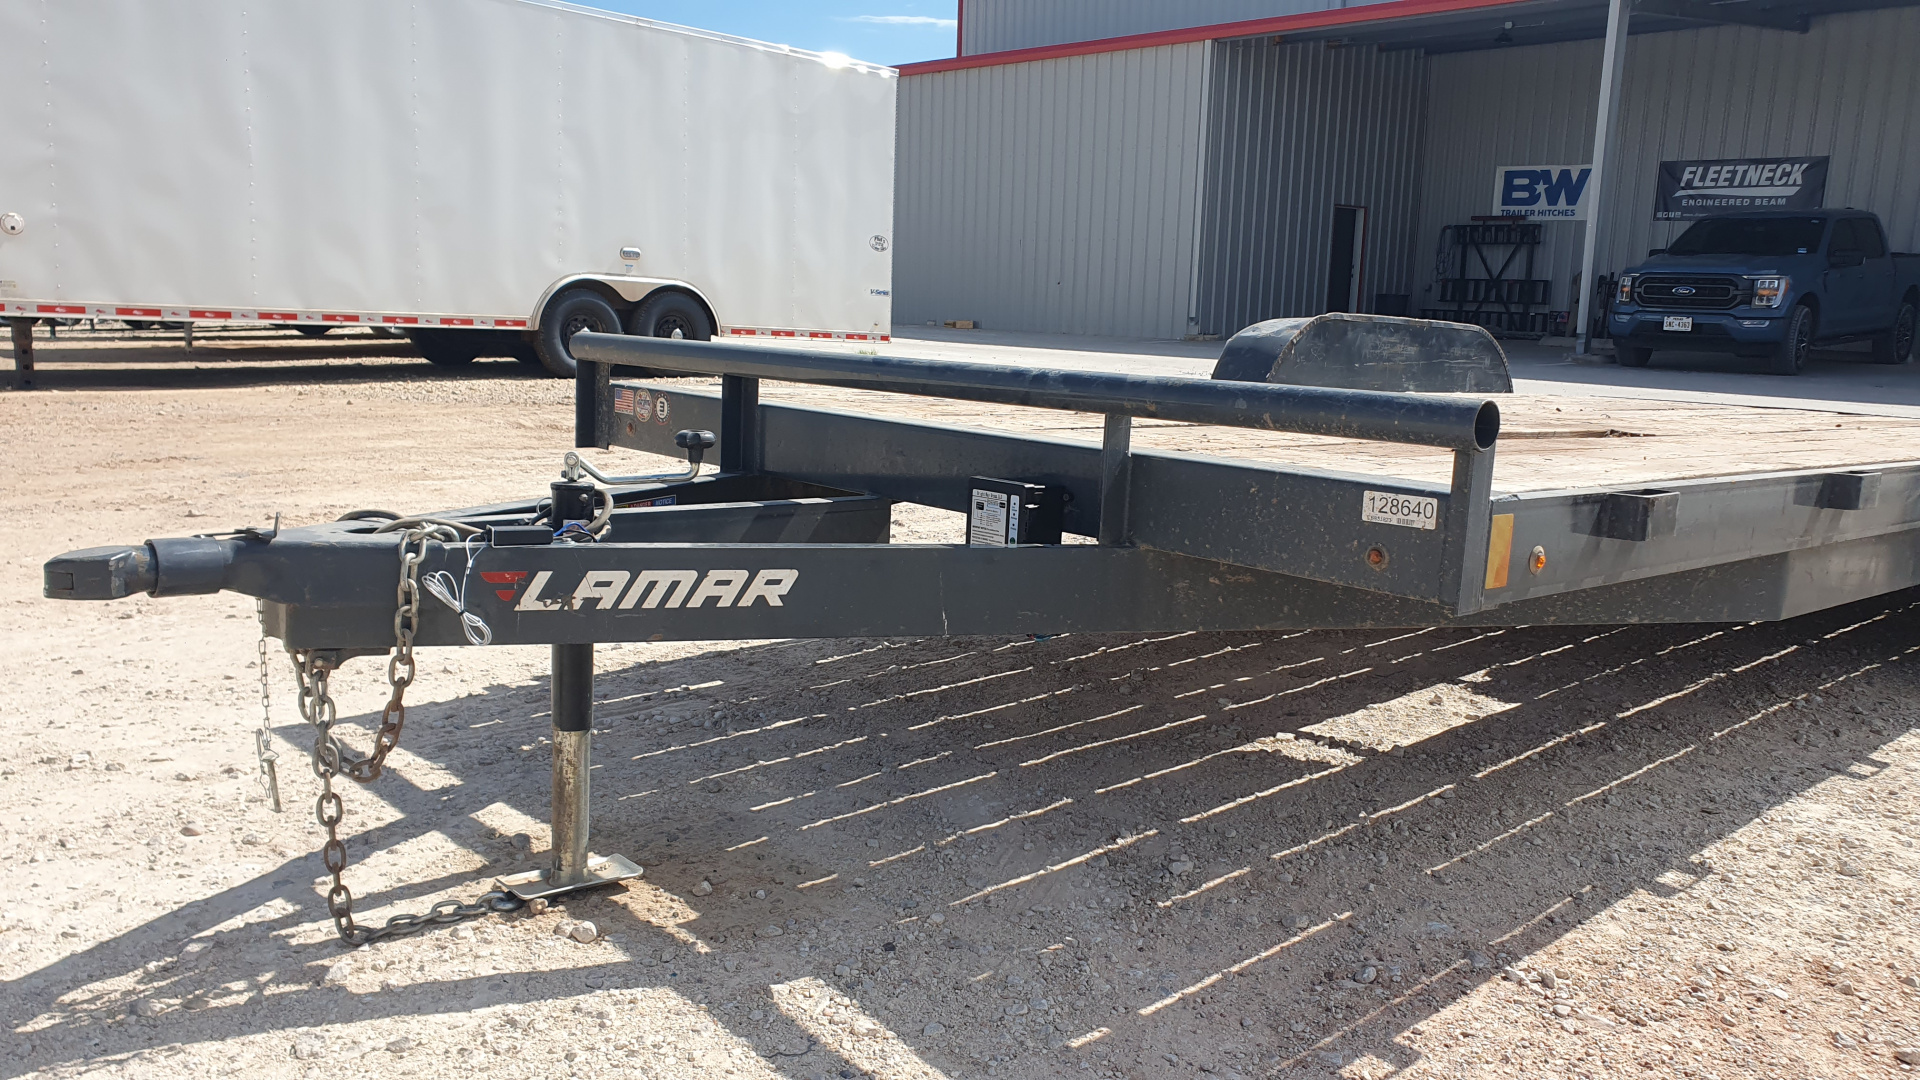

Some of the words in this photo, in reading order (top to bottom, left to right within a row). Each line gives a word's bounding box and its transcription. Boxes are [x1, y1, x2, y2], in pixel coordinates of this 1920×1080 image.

[1680, 163, 1809, 187] FLEETNECK
[1682, 198, 1750, 207] ENGINEERED
[1754, 197, 1787, 206] BEAM
[1500, 209, 1535, 217] TRAILER
[1537, 209, 1576, 217] HITCHES
[655, 498, 673, 506] NOTICE
[1369, 496, 1434, 519] 128640
[514, 569, 799, 611] LAMAR
